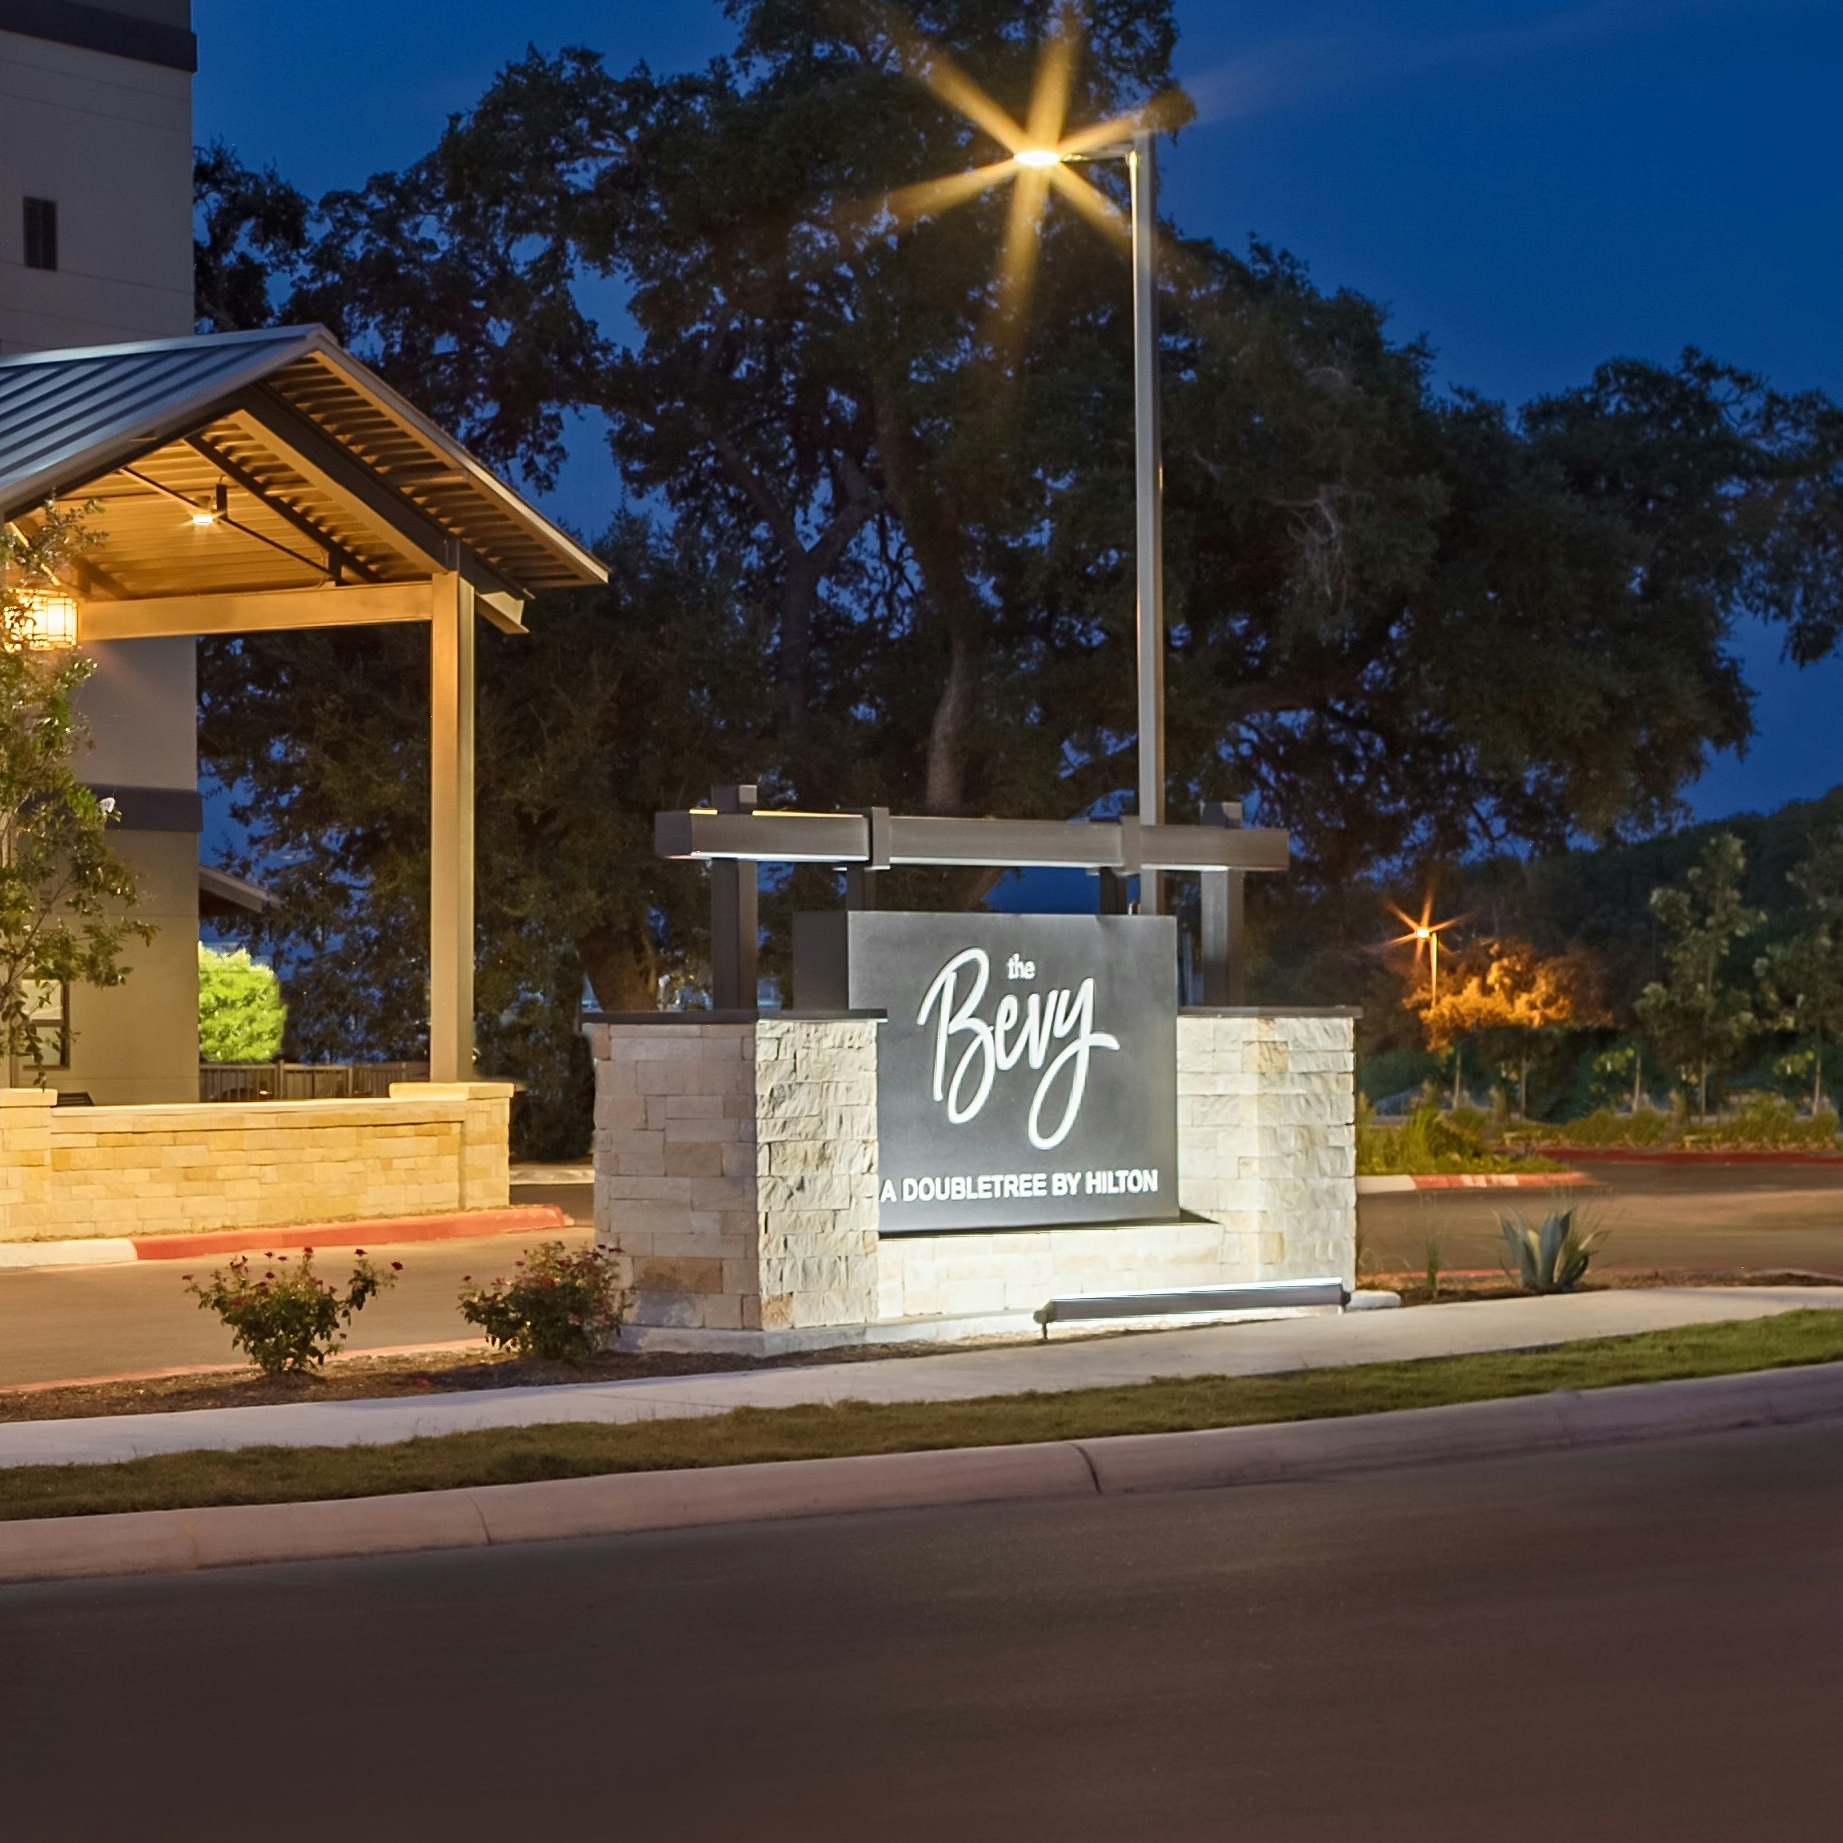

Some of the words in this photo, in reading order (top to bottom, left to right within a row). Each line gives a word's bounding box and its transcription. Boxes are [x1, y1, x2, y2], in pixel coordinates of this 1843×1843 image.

[1006, 953, 1035, 980] the
[917, 947, 1120, 1150] Bevy
[880, 1179, 897, 1203] A
[902, 1173, 1048, 1202] DOUBLETREE
[1051, 1172, 1082, 1196] BY
[1085, 1169, 1159, 1194] HILTON
